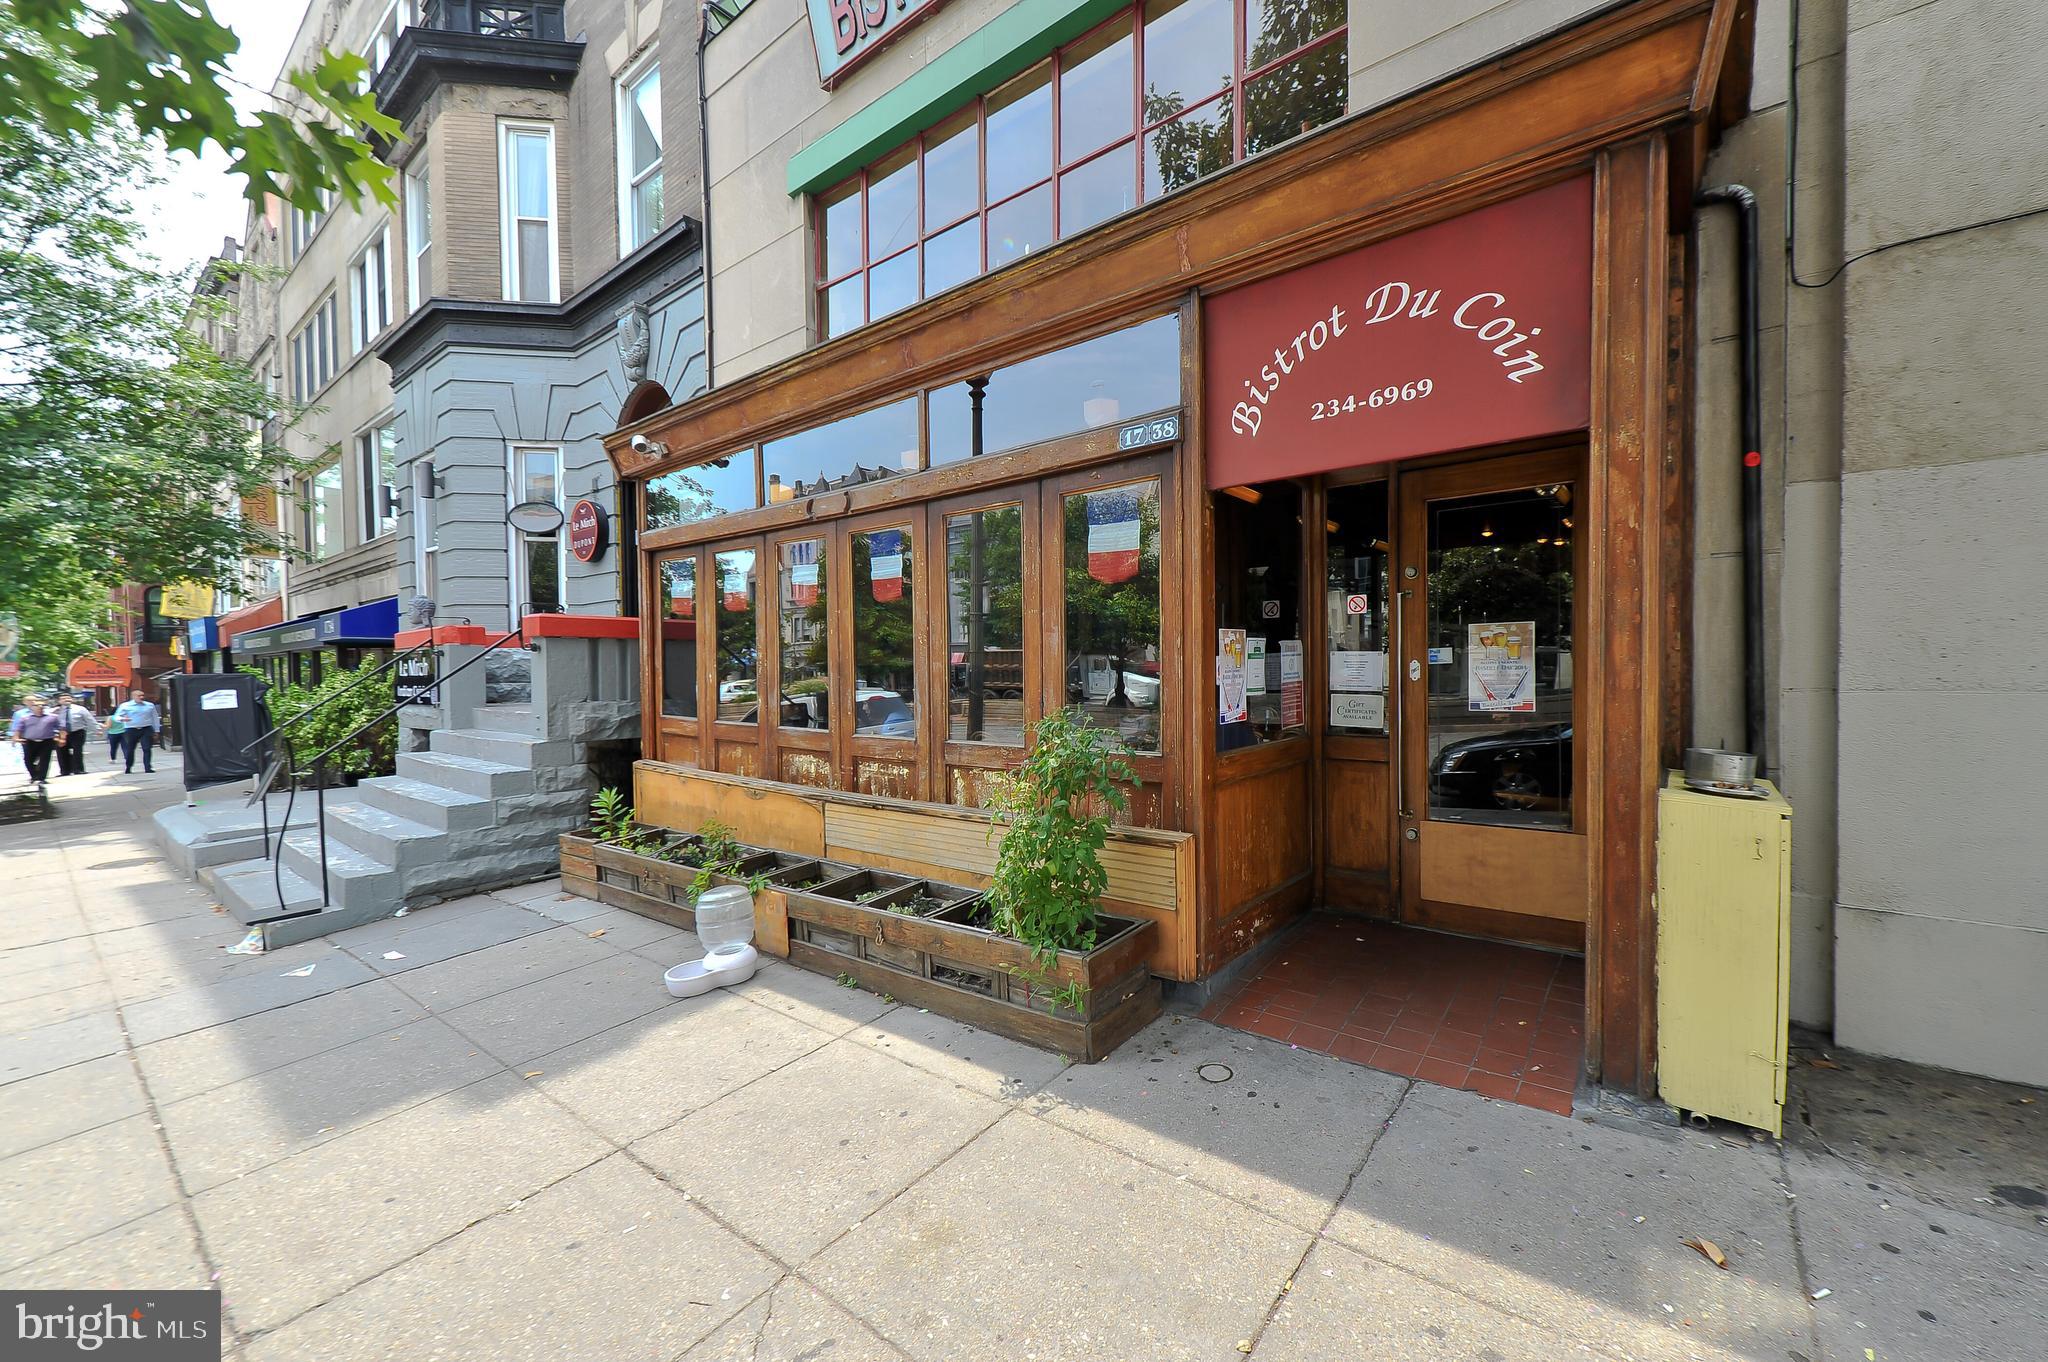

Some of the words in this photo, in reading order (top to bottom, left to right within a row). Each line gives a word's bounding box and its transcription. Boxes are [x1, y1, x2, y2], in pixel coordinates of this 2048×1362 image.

[1231, 304, 1348, 437] Bistrot
[1365, 281, 1442, 325] Du
[1453, 292, 1545, 384] Coin
[1311, 378, 1433, 421] 234-6969
[573, 536, 596, 549] DUPONT
